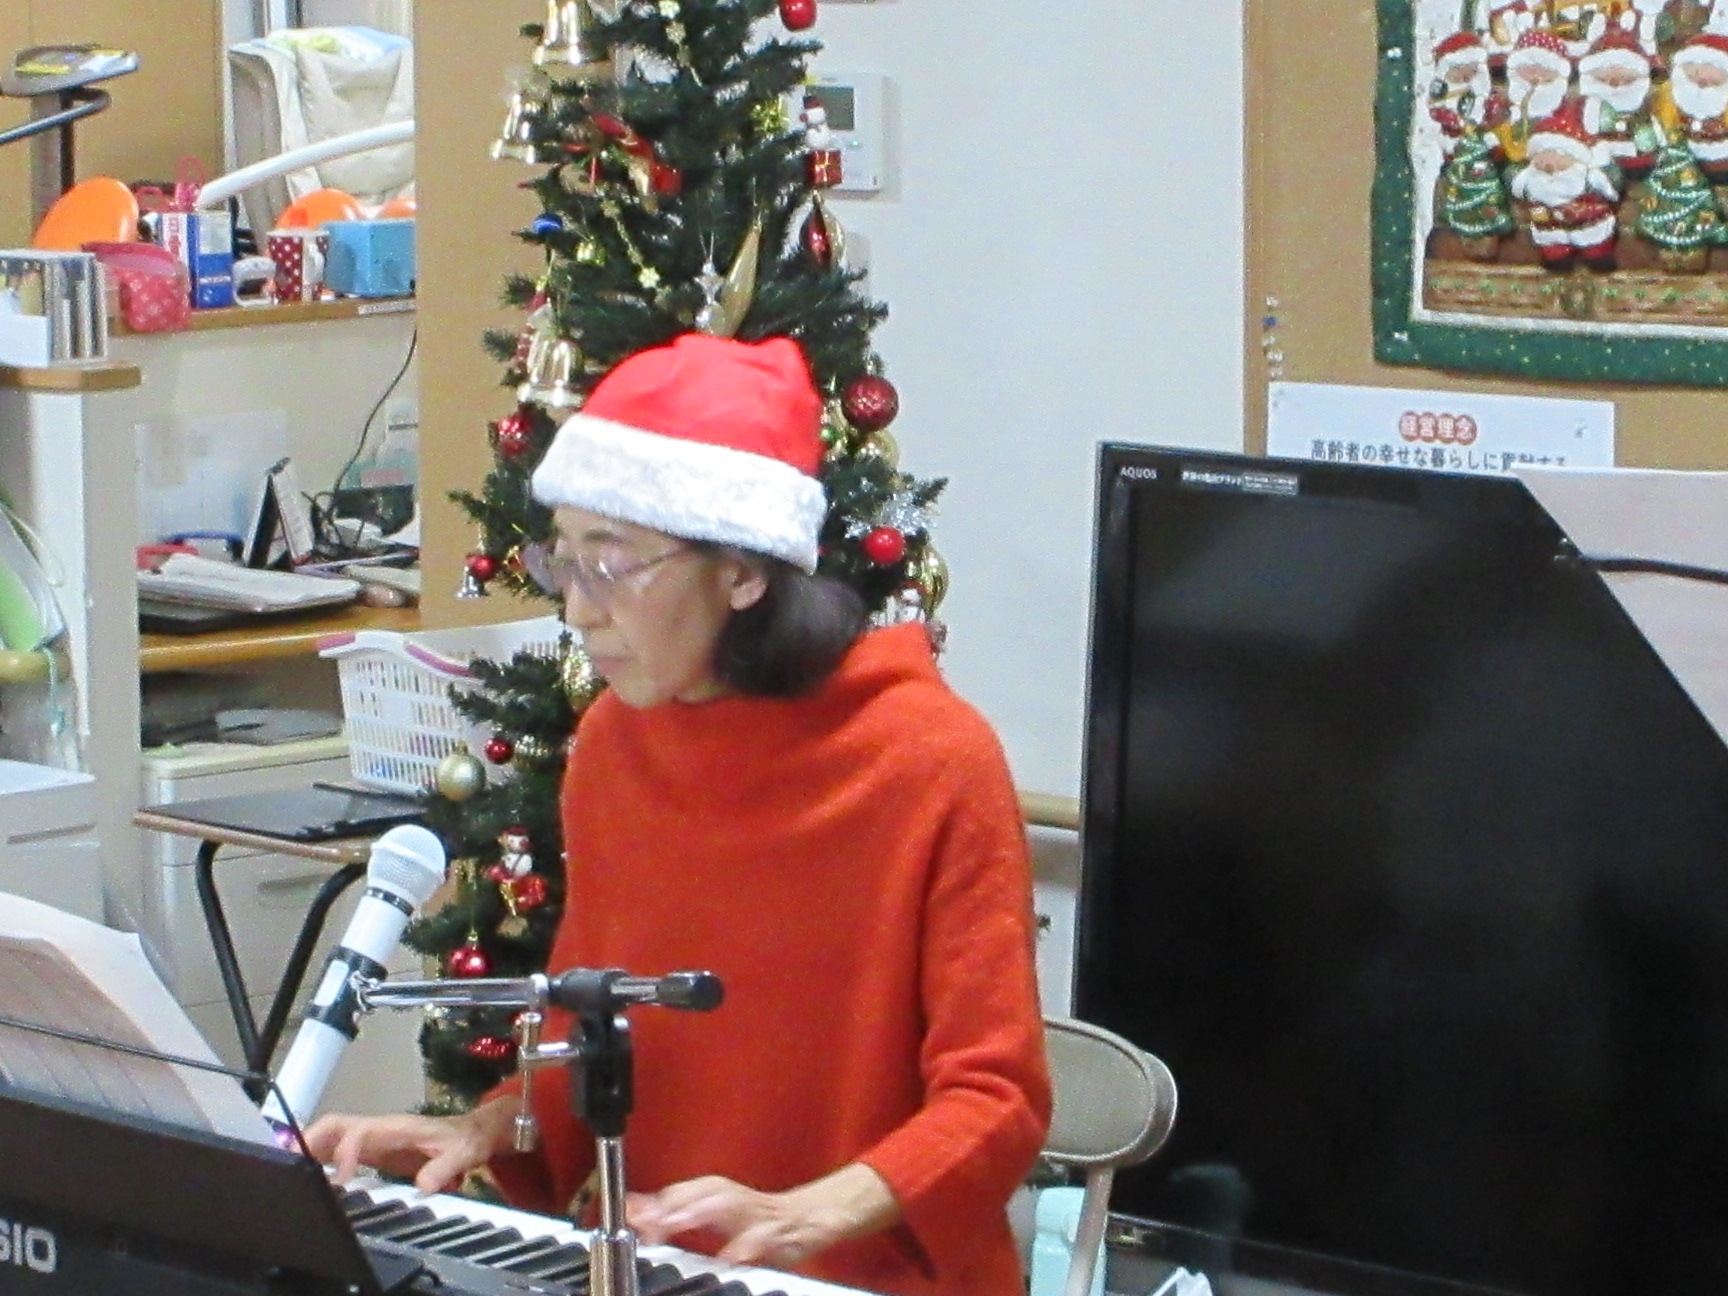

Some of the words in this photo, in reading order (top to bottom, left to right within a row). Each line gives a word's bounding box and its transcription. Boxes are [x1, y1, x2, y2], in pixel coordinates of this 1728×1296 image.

[1400, 412, 1477, 444] 経営理念
[1120, 465, 1158, 480] AQUOS
